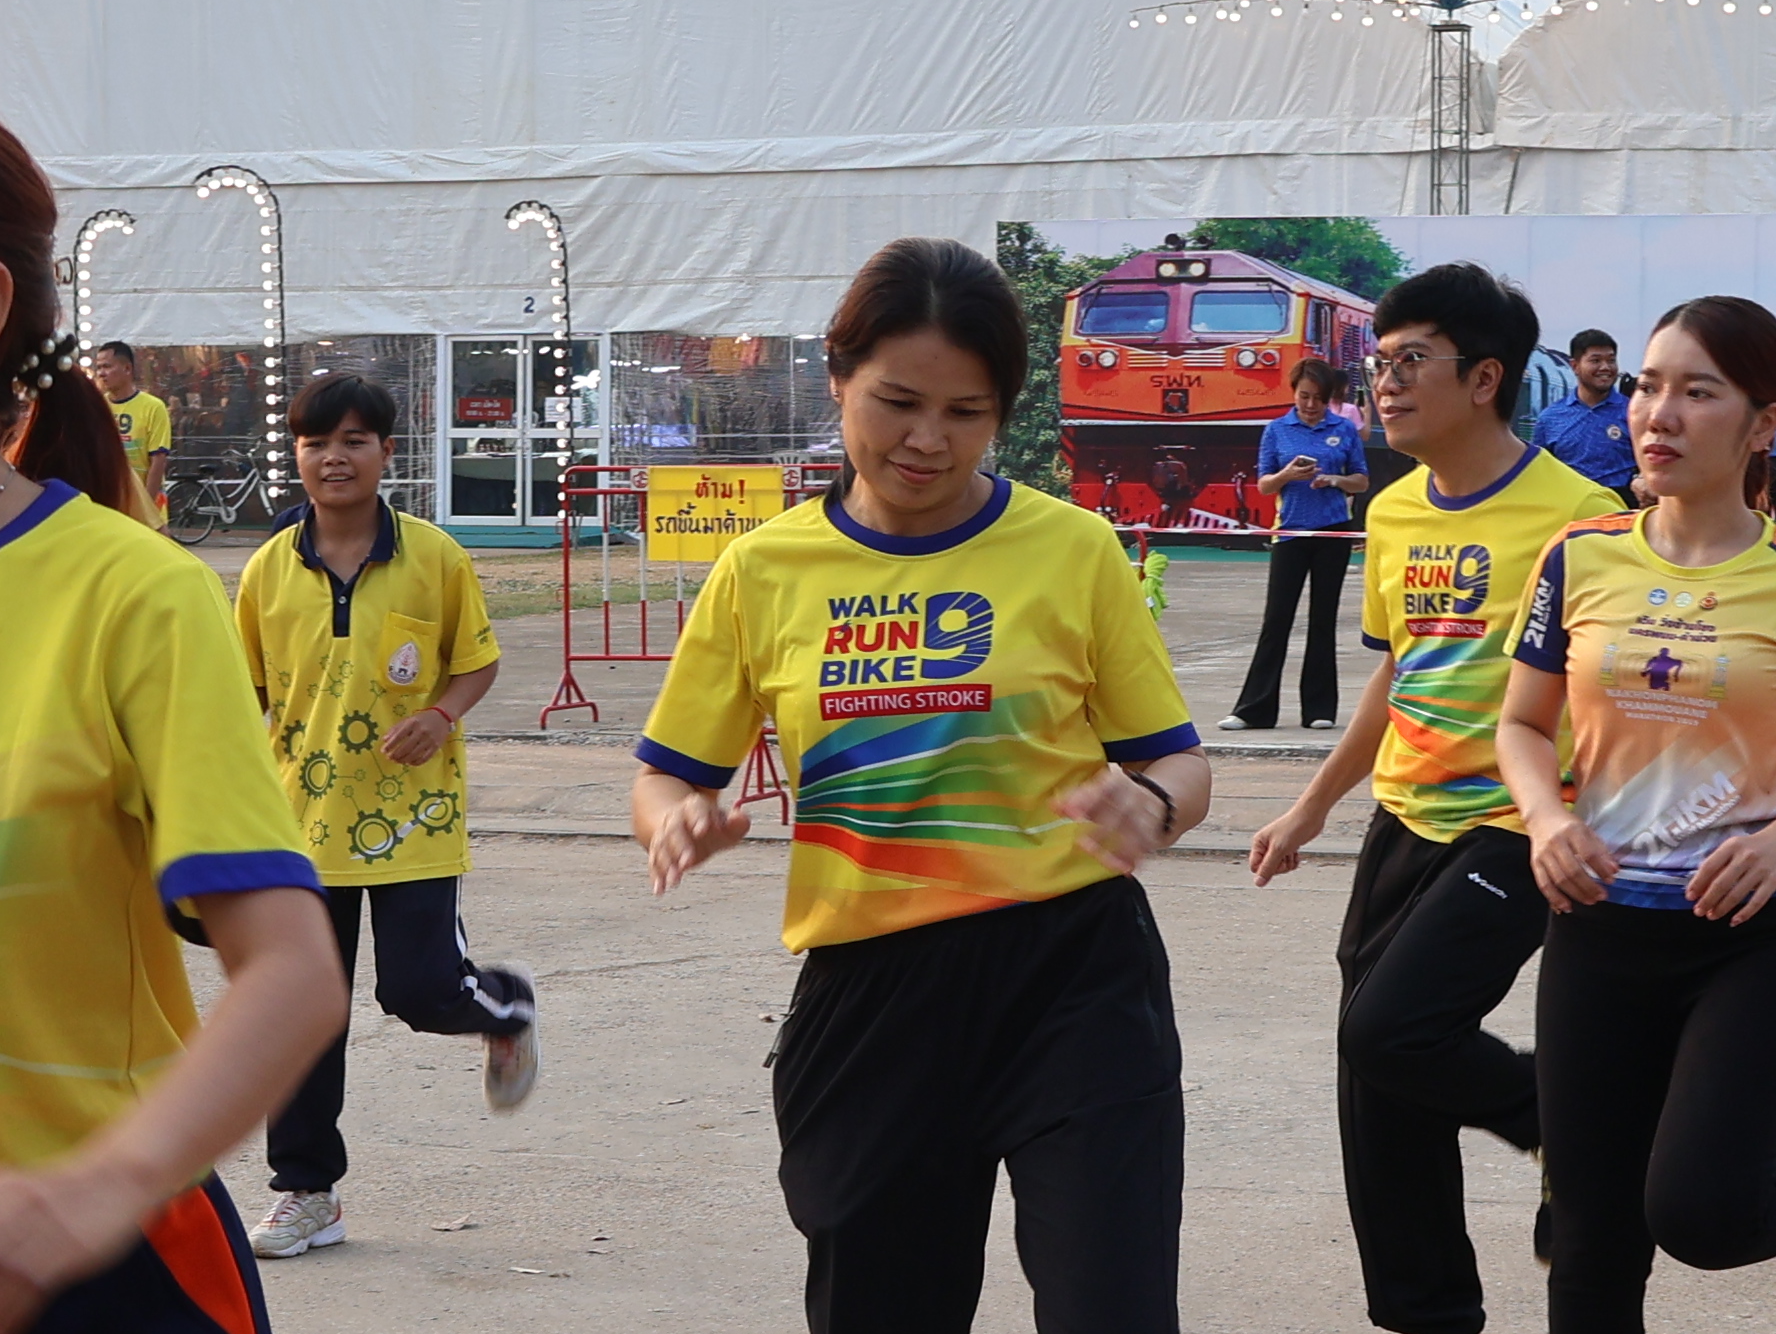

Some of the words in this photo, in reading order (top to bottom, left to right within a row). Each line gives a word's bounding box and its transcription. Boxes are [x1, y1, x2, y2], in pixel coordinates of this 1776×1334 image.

[524, 297, 535, 313] 2
[1409, 544, 1457, 561] WALK
[1404, 565, 1452, 588] RUN
[1454, 544, 1491, 614] 9
[828, 592, 920, 619] WALK
[1404, 593, 1451, 614] BIKE
[824, 620, 919, 655] RUN
[922, 592, 994, 679] 9
[819, 656, 916, 687] BIKE
[825, 691, 911, 714] FIGHTING
[916, 689, 985, 711] STROKE
